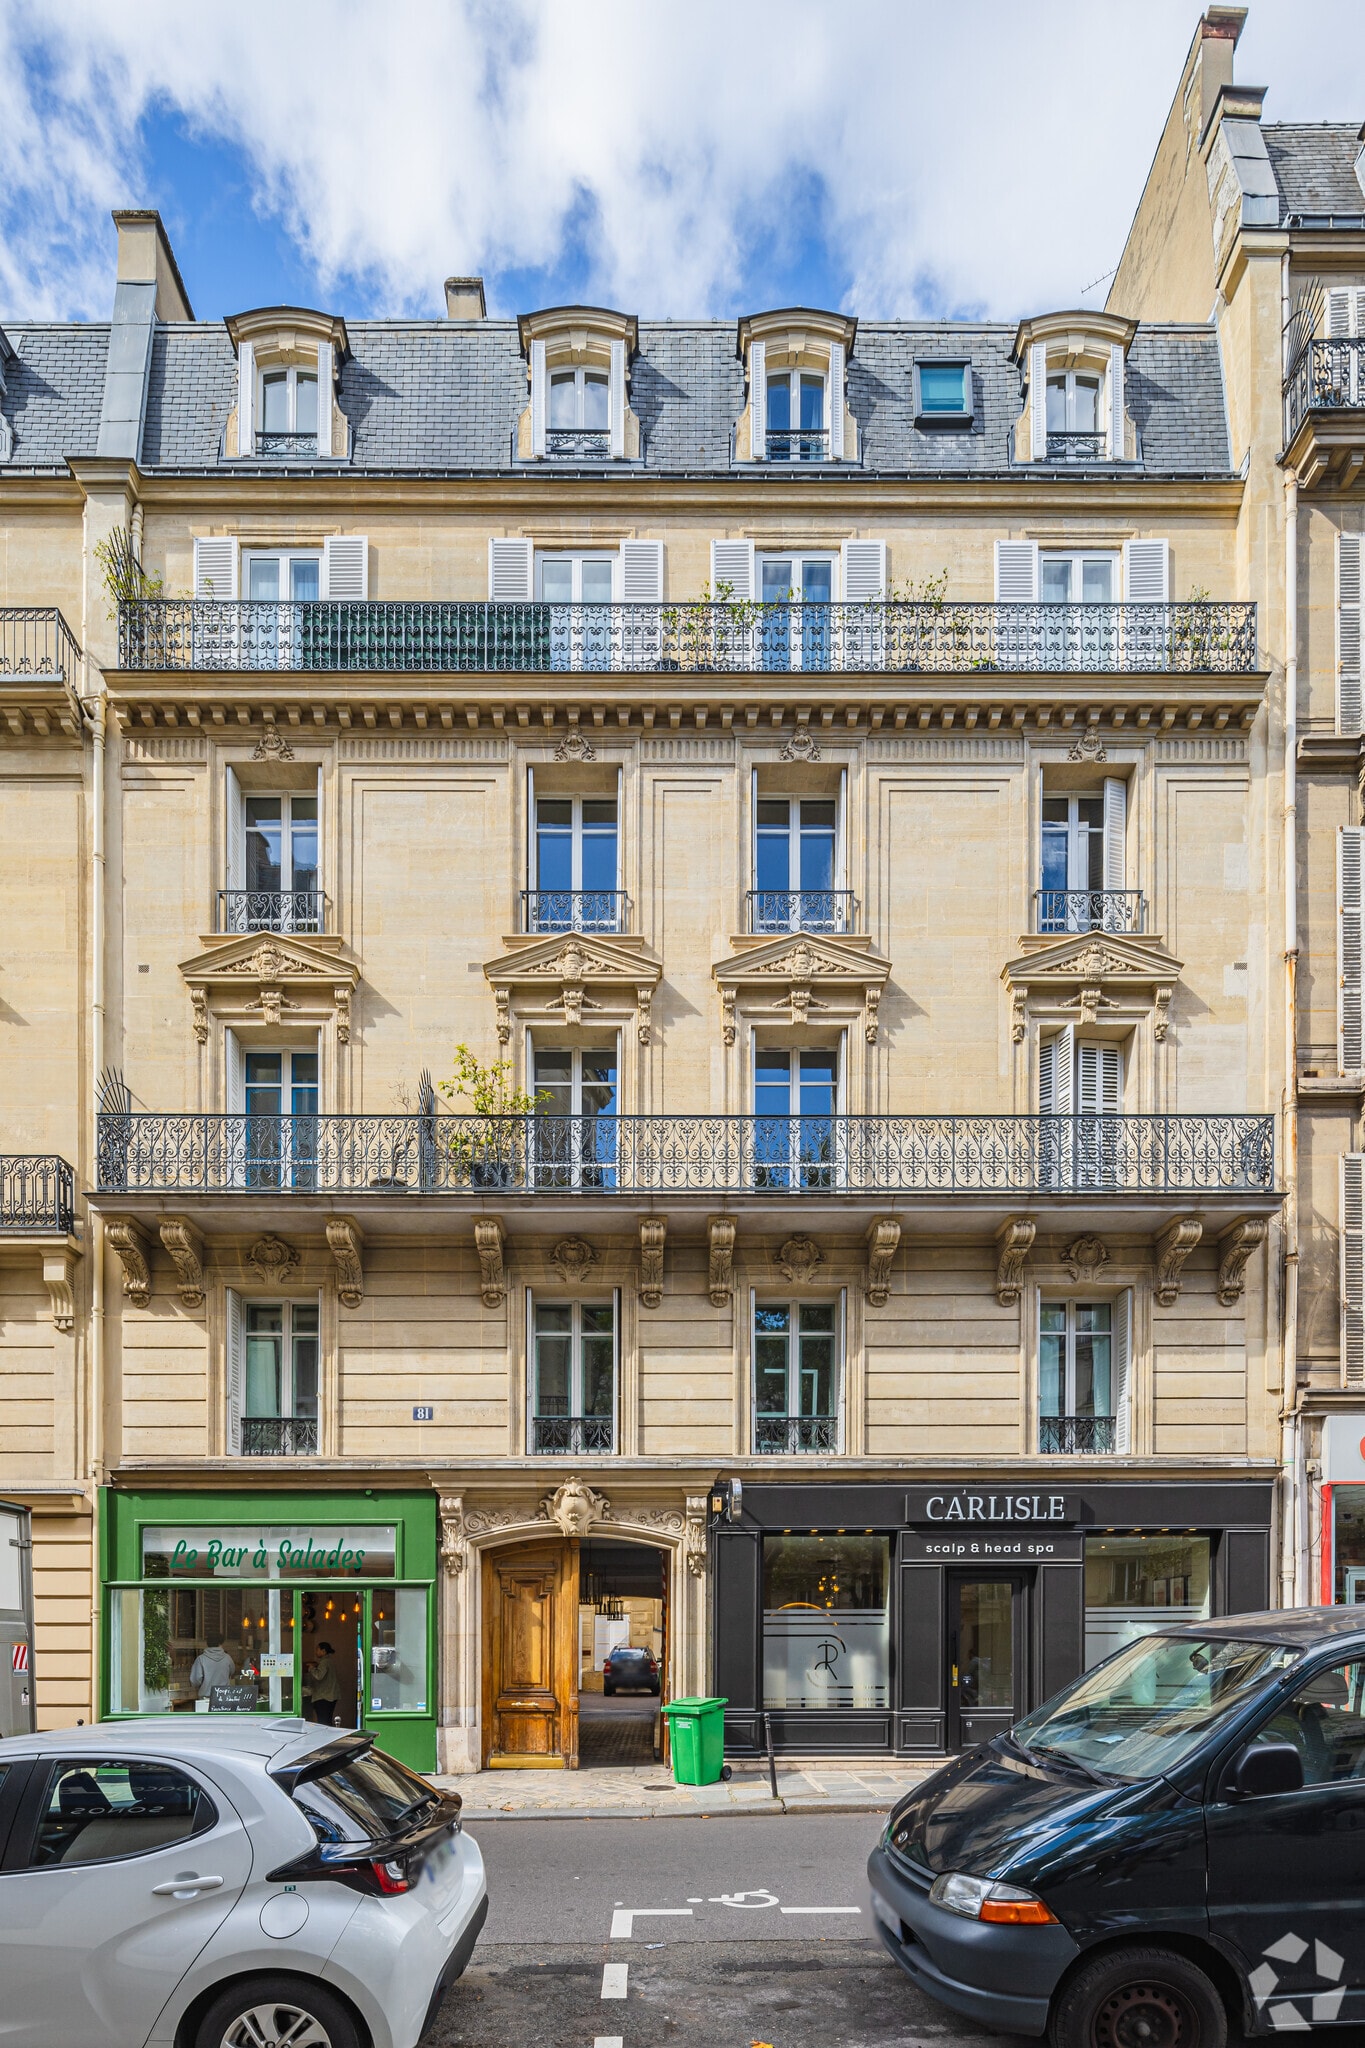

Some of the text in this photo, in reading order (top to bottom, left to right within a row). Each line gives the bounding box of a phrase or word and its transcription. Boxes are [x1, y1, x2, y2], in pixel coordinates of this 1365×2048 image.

[417, 1407, 429, 1419] 81
[926, 1496, 1065, 1520] CARLISLE
[170, 1538, 365, 1568] Le Bar à Salades
[926, 1543, 1054, 1555] scalp & head spa
